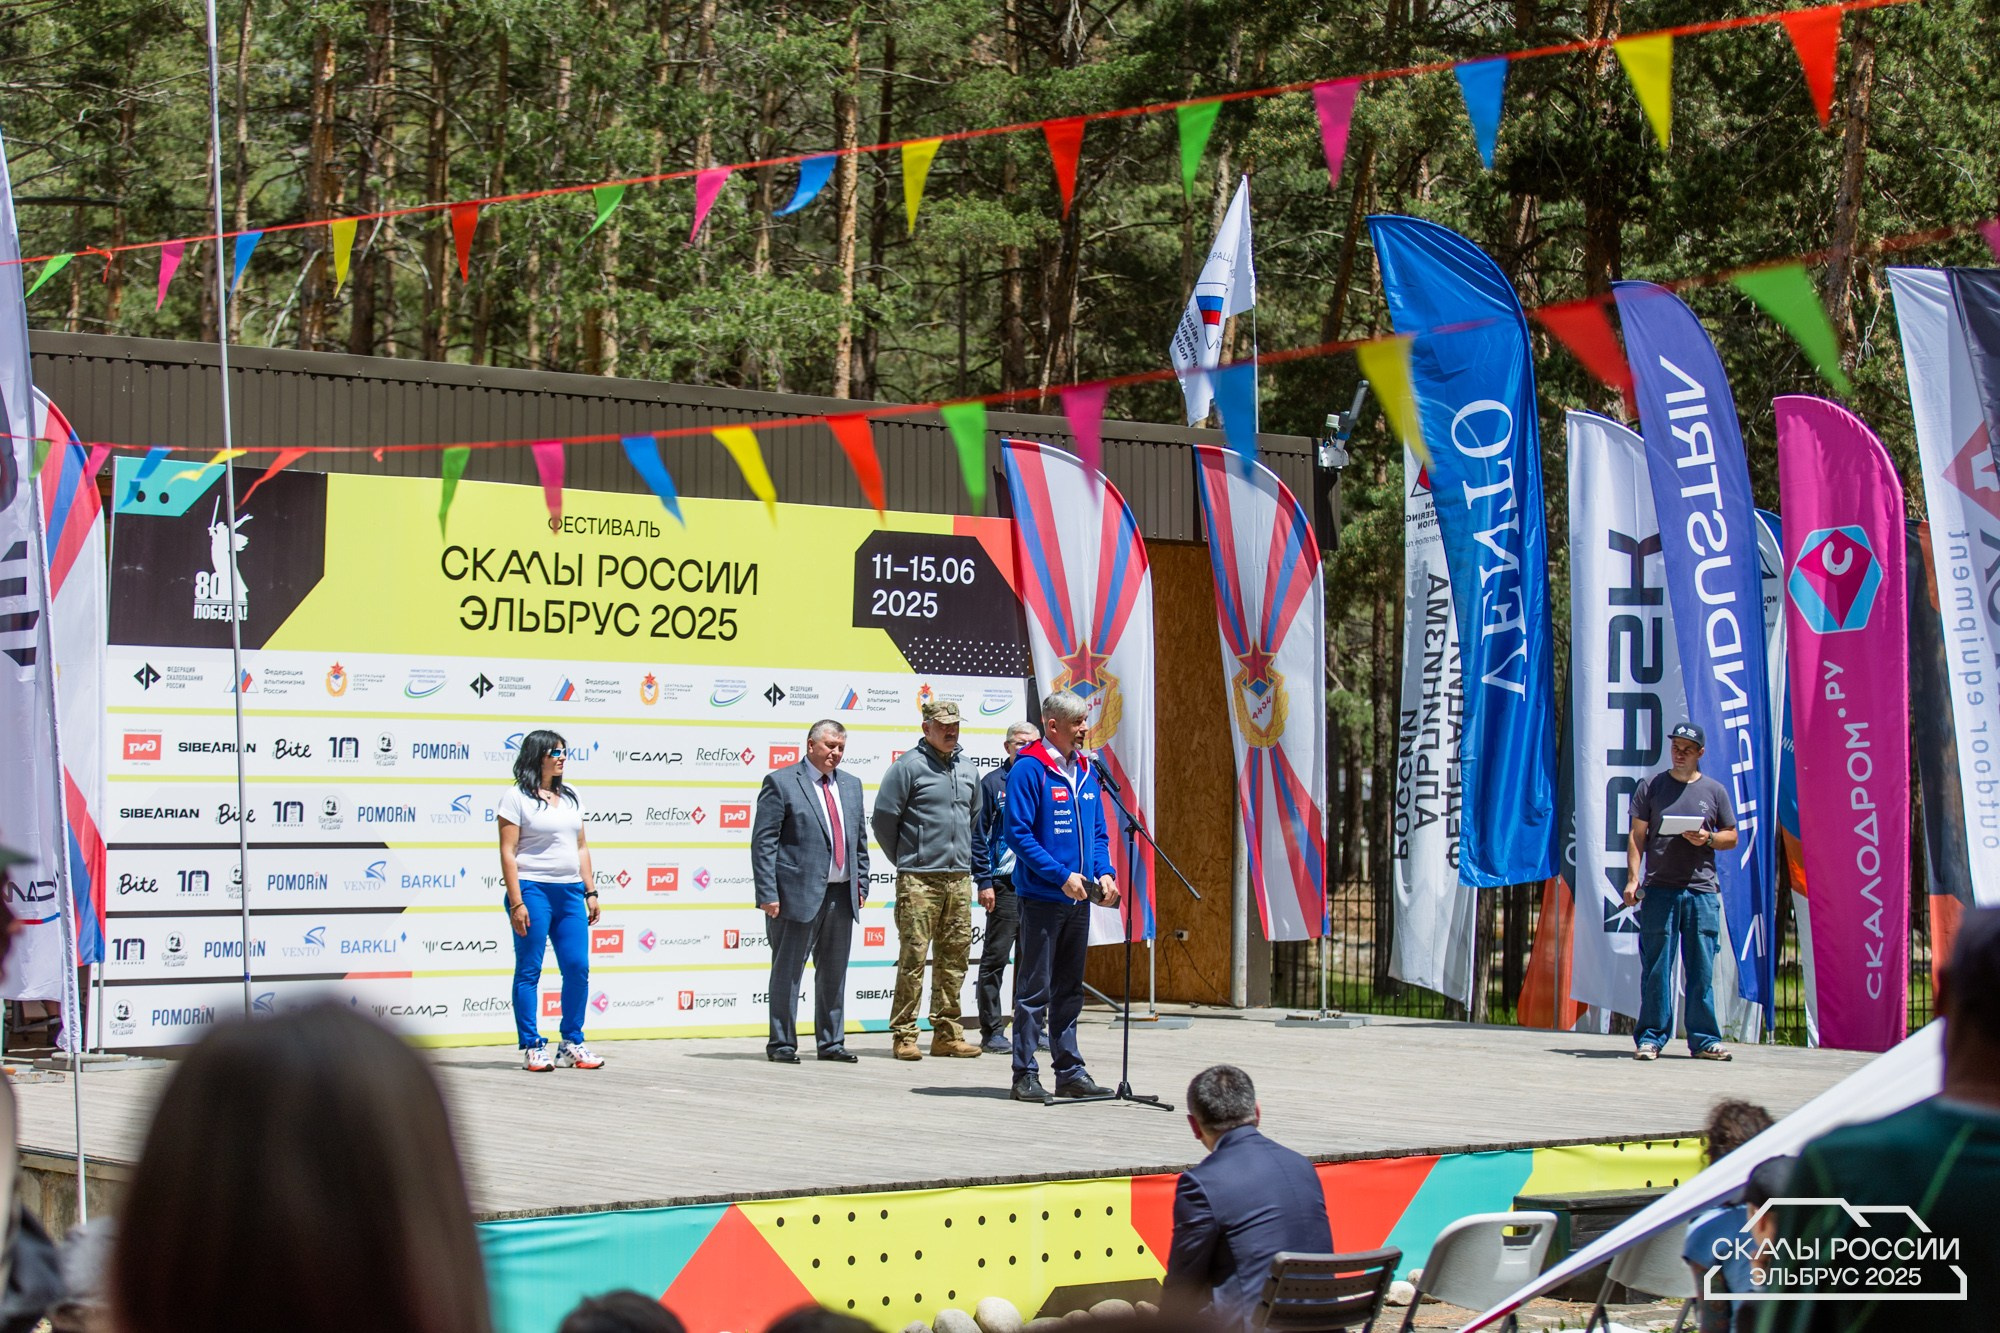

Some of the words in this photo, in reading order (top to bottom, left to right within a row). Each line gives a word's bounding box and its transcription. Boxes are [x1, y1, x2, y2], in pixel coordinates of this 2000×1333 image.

[1185, 305, 1199, 343] ussian
[548, 516, 661, 537] ФЕСТИВАЛЬ
[441, 545, 583, 586] СКАЛЫ
[598, 555, 758, 596] РОССИИ
[872, 589, 938, 618] 2025
[460, 595, 640, 637] ЭЛЬБРУС
[650, 604, 738, 641] 2025
[275, 738, 311, 759] Bite
[566, 748, 589, 761] KLI
[696, 747, 741, 762] RedFox
[630, 751, 683, 762] CAMP
[120, 807, 200, 819] SIBEARIAN
[217, 804, 256, 824] Bie
[431, 813, 466, 824] VENTO
[646, 807, 691, 821] RedFox
[119, 873, 158, 894] Bite
[344, 880, 381, 891] VENTO
[401, 875, 455, 888] BARKLI
[340, 939, 396, 954] BARKLI
[441, 941, 497, 952] CAMP
[741, 937, 755, 947] TOP
[282, 947, 320, 958] VENTO
[463, 997, 511, 1011] RedFox
[695, 999, 711, 1008] TOP
[713, 998, 737, 1008] POINT
[390, 1005, 448, 1017] CAMP
